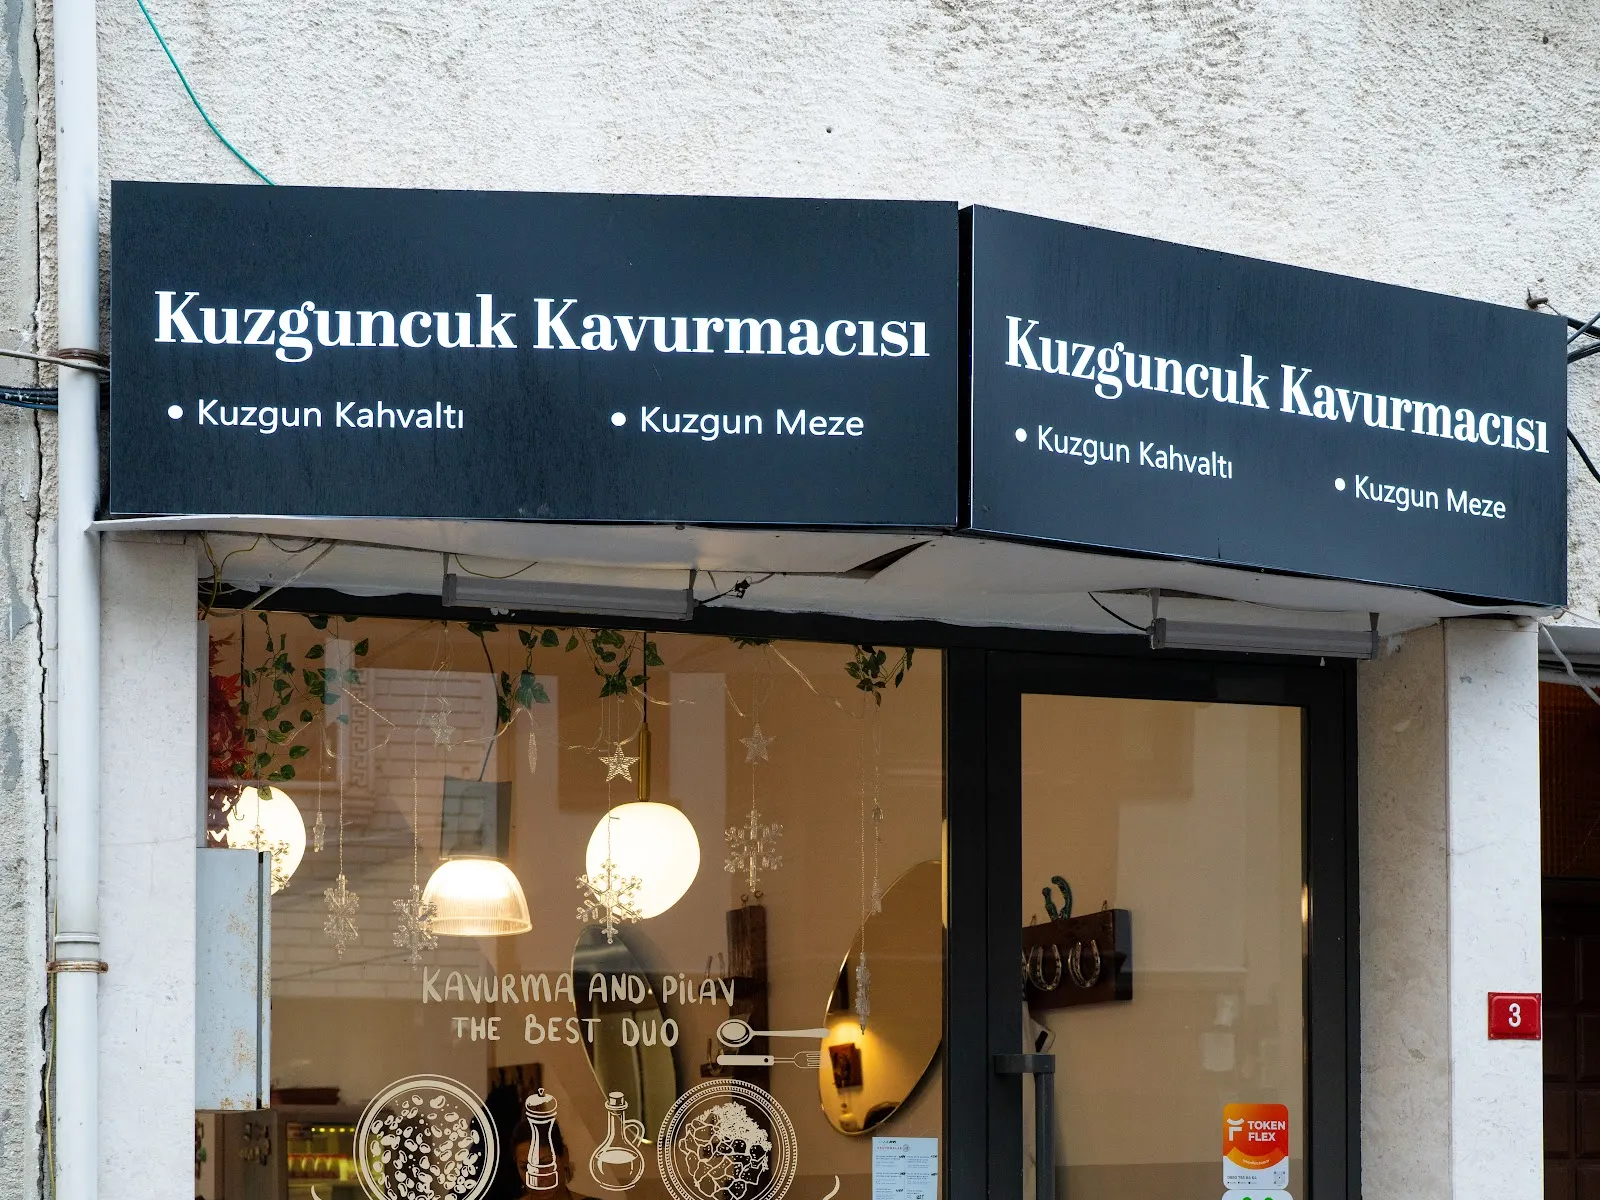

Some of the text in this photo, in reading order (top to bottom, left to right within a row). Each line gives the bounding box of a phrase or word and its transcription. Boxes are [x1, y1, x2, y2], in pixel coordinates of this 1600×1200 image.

[154, 290, 931, 363] Kuzguncuk Kavurmacısı
[1004, 315, 1550, 454] Kuzguncuk Kavurmacısı
[198, 398, 464, 435] Kuzgun Kahvaltı
[641, 406, 864, 442] Kuzgun Meze
[1038, 424, 1233, 480] Kuzgun Kahvaltı
[1355, 474, 1507, 520] Kuzgun Meze
[422, 965, 574, 1005] KAVURMA
[588, 972, 646, 1005] AND
[452, 1013, 679, 1047] THE BEST DUO
[1508, 1002, 1522, 1028] 3
[1247, 1120, 1286, 1131] TOKEN
[1248, 1131, 1276, 1142] FLEX
